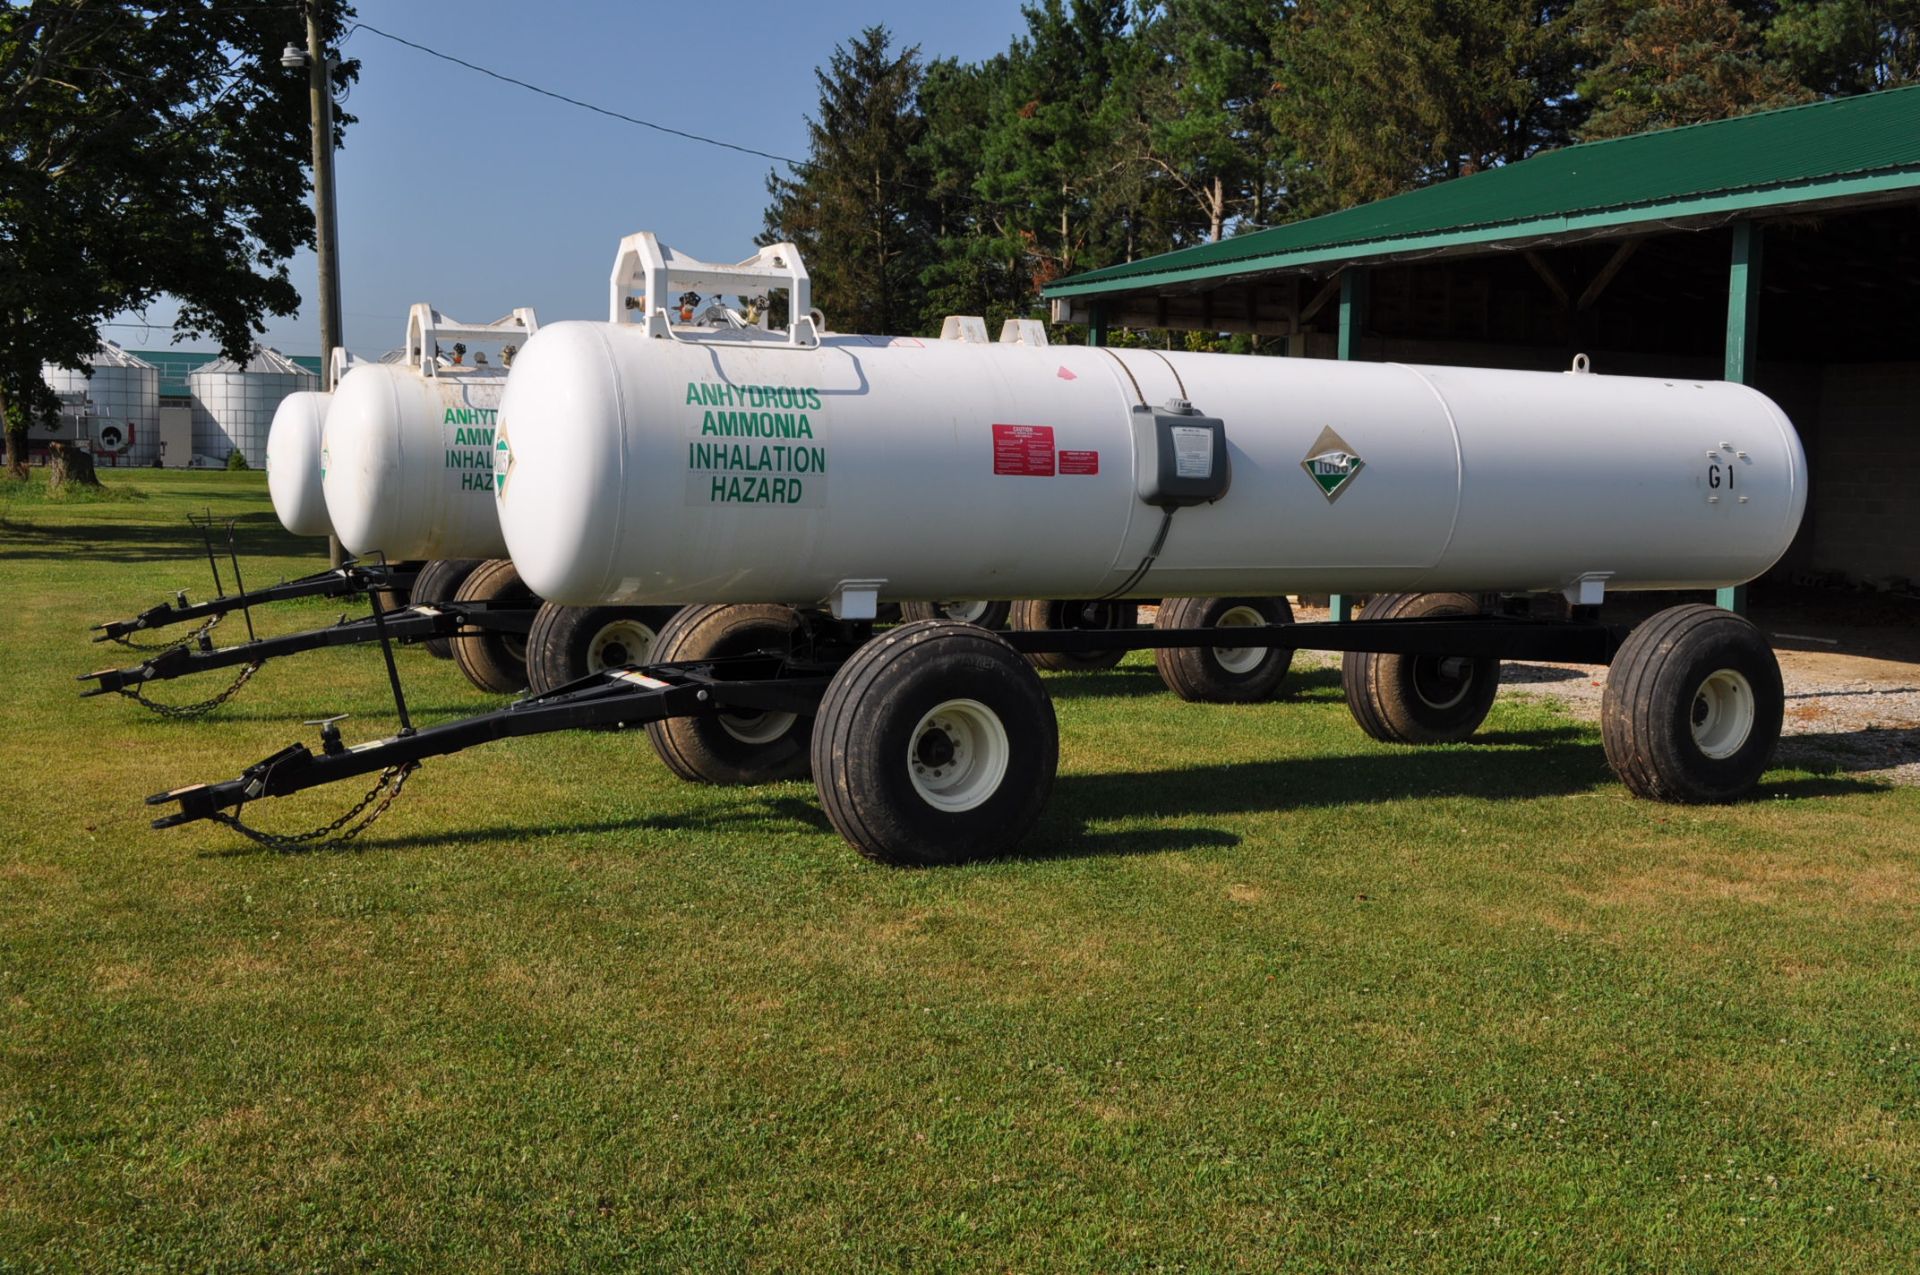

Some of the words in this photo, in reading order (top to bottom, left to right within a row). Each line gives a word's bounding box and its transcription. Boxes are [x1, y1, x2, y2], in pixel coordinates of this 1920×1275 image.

[686, 382, 822, 410] ANHYDROUS
[702, 410, 814, 439] AMMONIA
[689, 442, 825, 473] INHALATION
[711, 476, 803, 504] HAZARD
